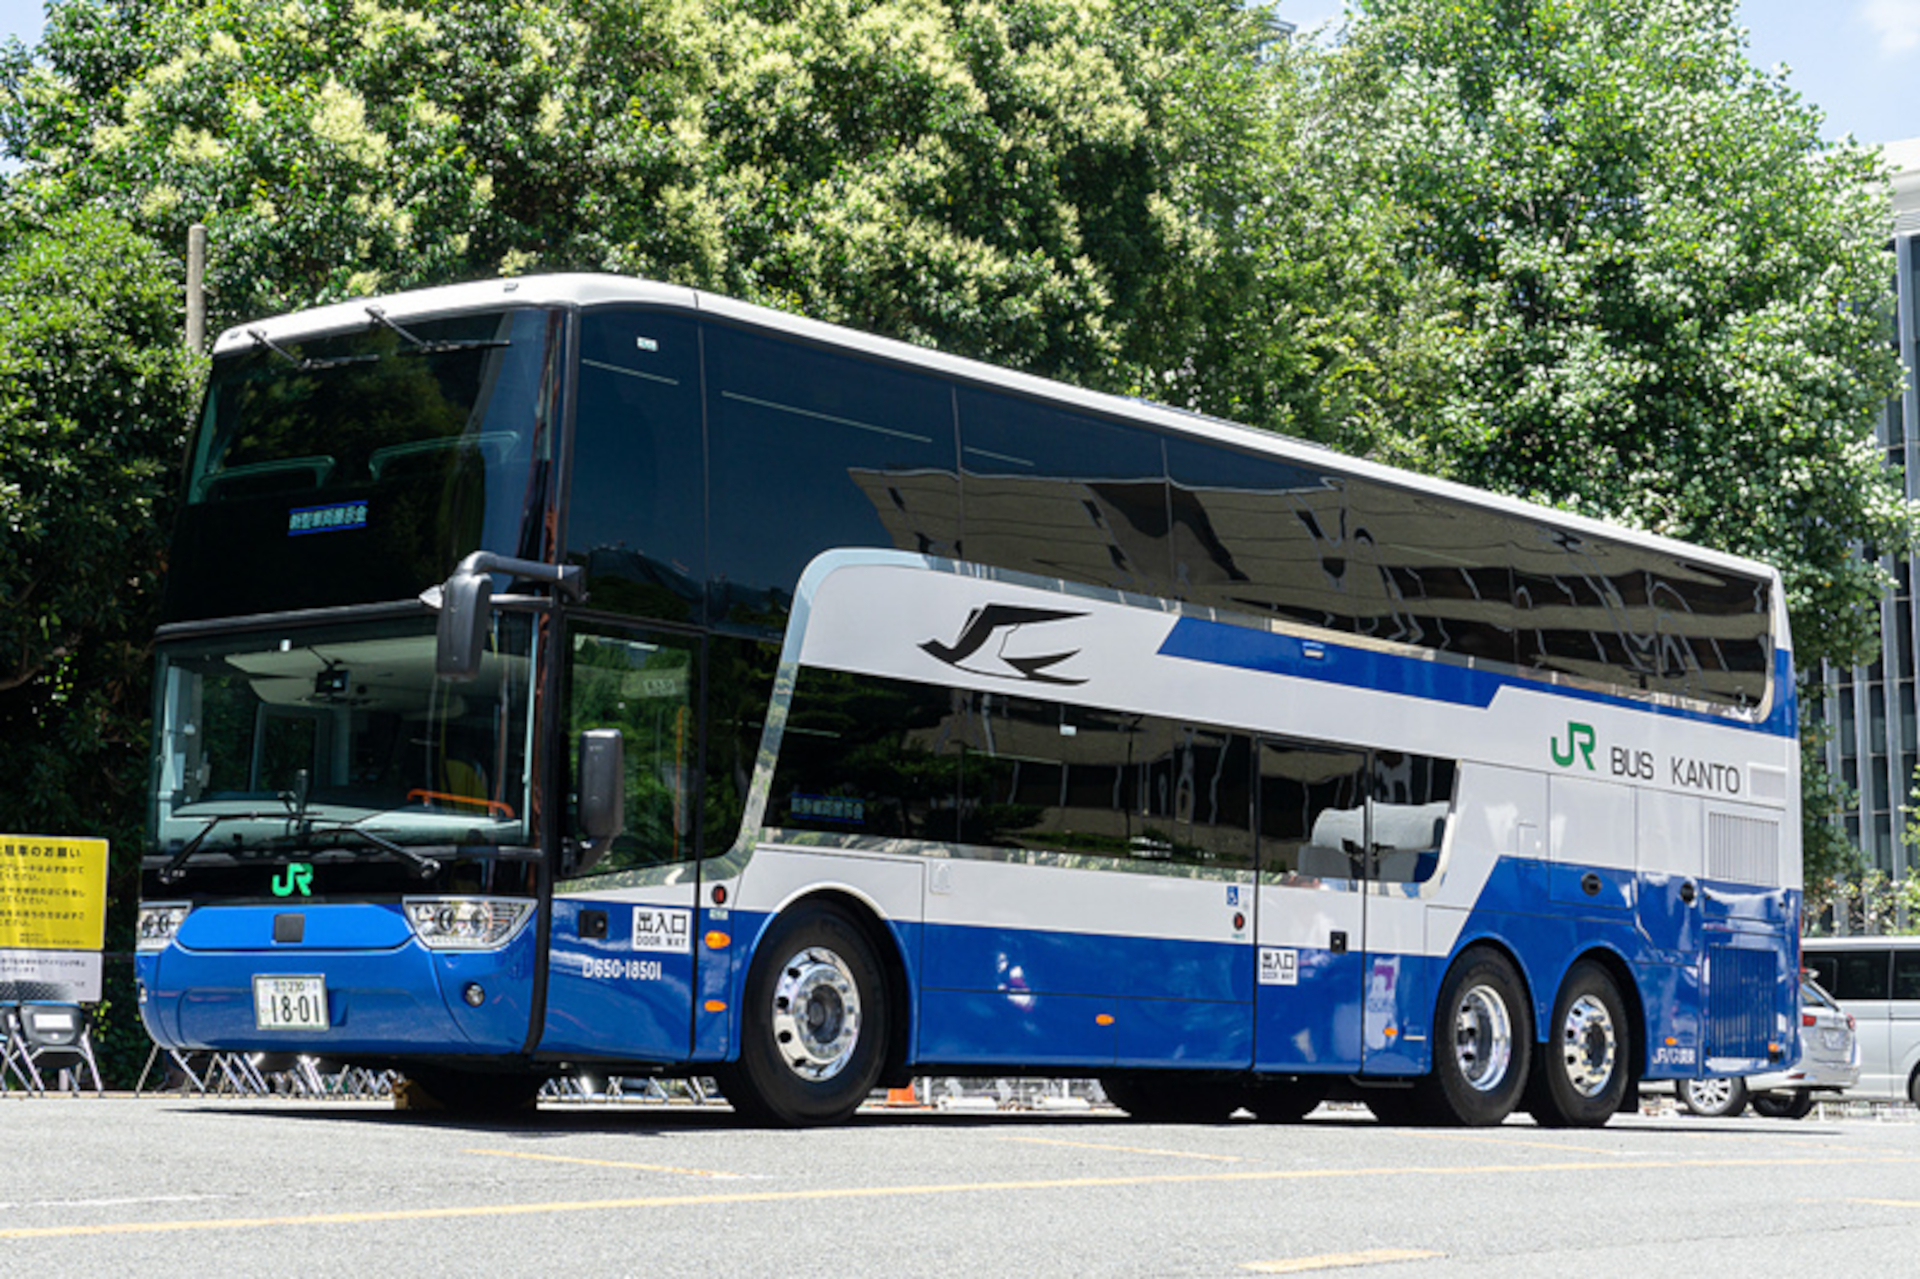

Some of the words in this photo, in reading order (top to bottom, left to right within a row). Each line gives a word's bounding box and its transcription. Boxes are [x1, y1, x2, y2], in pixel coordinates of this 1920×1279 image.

[1551, 721, 1595, 770] JR
[1611, 747, 1653, 779] BUS
[1671, 757, 1740, 793] KANTO
[0, 845, 81, 858] 駐車のお願い
[272, 863, 313, 896] JR
[637, 912, 687, 935] 出入口
[636, 935, 660, 946] DOOR
[667, 938, 686, 947] WAY
[1262, 952, 1294, 970] 出入口
[271, 994, 320, 1023] 18-01
